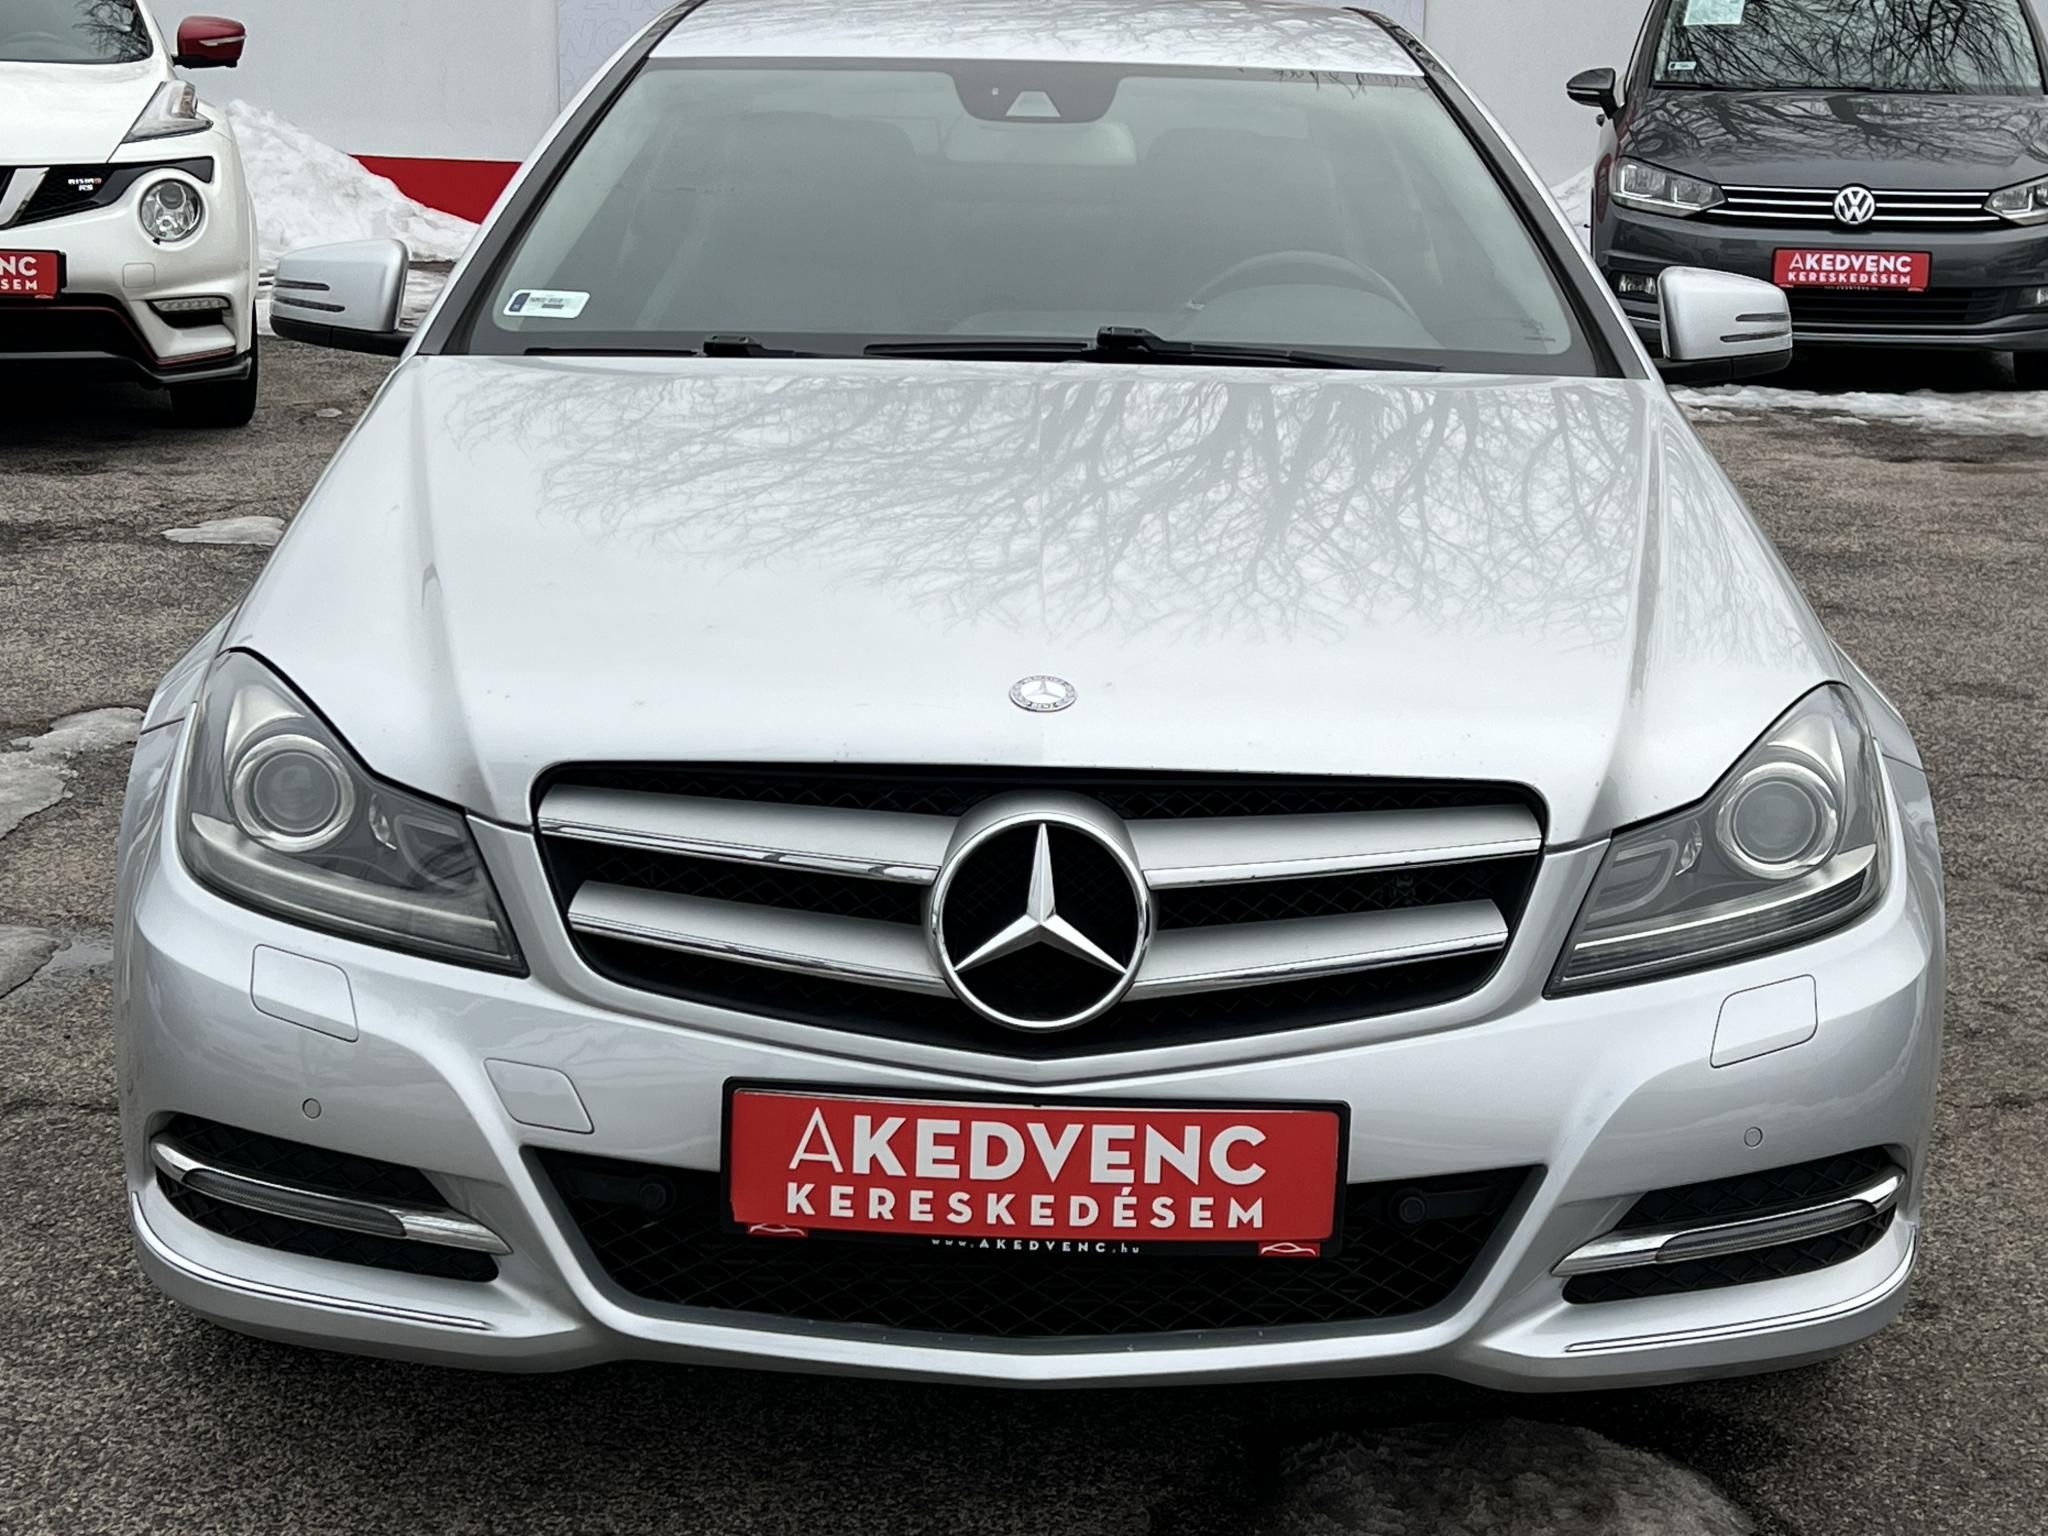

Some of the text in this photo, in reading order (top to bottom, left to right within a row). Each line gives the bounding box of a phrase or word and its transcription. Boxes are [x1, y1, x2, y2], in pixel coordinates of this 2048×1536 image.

[1789, 253, 1912, 272] AKEDVENC
[1788, 271, 1911, 284] KERESKEDÉSEM
[788, 1106, 1267, 1186] AKEDVENC
[786, 1181, 1263, 1229] KERESKEDÉSEM
[931, 1238, 1139, 1254] www.AKEDVENC.hu
